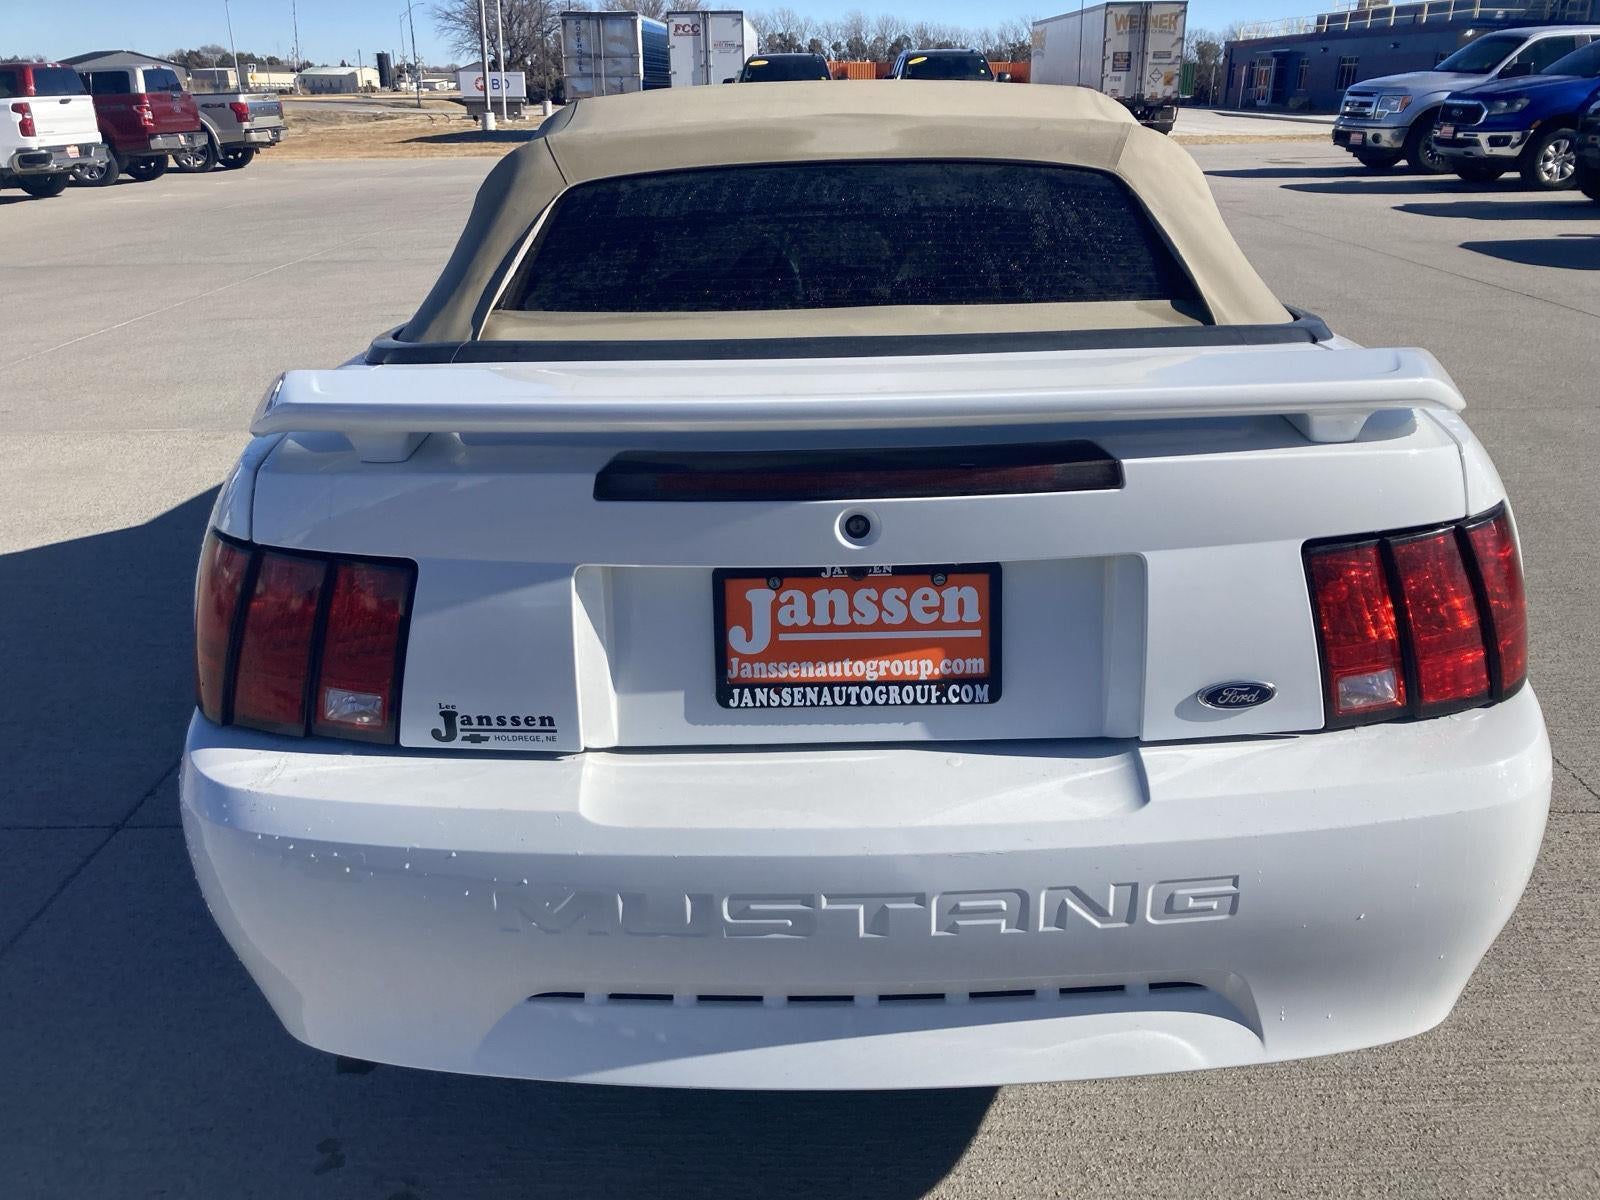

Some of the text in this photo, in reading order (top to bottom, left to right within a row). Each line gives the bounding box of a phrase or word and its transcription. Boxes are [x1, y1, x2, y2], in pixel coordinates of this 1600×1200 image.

[674, 23, 700, 33] FCC
[821, 564, 892, 578] JAEN
[728, 585, 981, 654] Janssen
[727, 656, 985, 681] Janssenautogroup.com
[438, 702, 457, 710] Lee
[729, 683, 990, 708] JANSSENAUTOGROUP.COM
[1217, 687, 1259, 704] Ford
[431, 710, 556, 742] Janssen
[494, 734, 544, 743] HOLDREGE,
[493, 874, 1240, 938] MUSTANG
